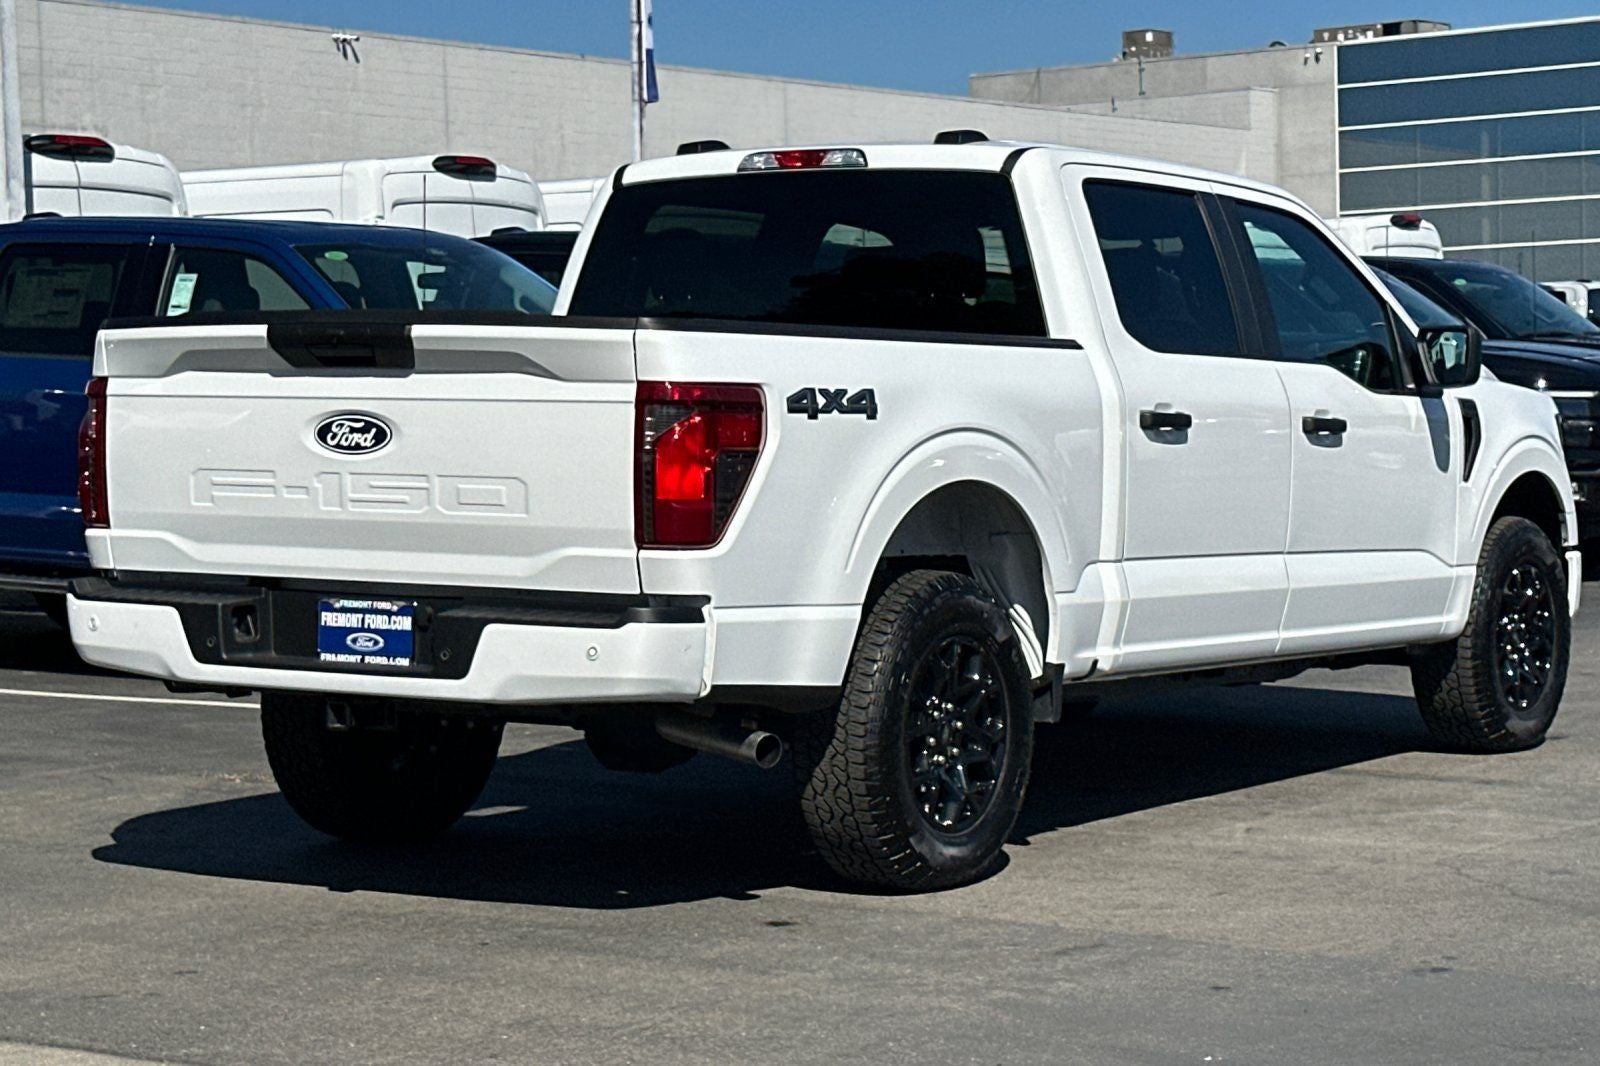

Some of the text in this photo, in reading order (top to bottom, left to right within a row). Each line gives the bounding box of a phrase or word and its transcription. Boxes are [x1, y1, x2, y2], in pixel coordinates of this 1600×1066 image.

[326, 419, 377, 449] Ford
[190, 468, 529, 517] F-150
[340, 599, 392, 610] FREMONT FORD
[321, 611, 412, 631] FREMONT FORD.COM
[355, 636, 376, 648] Ford
